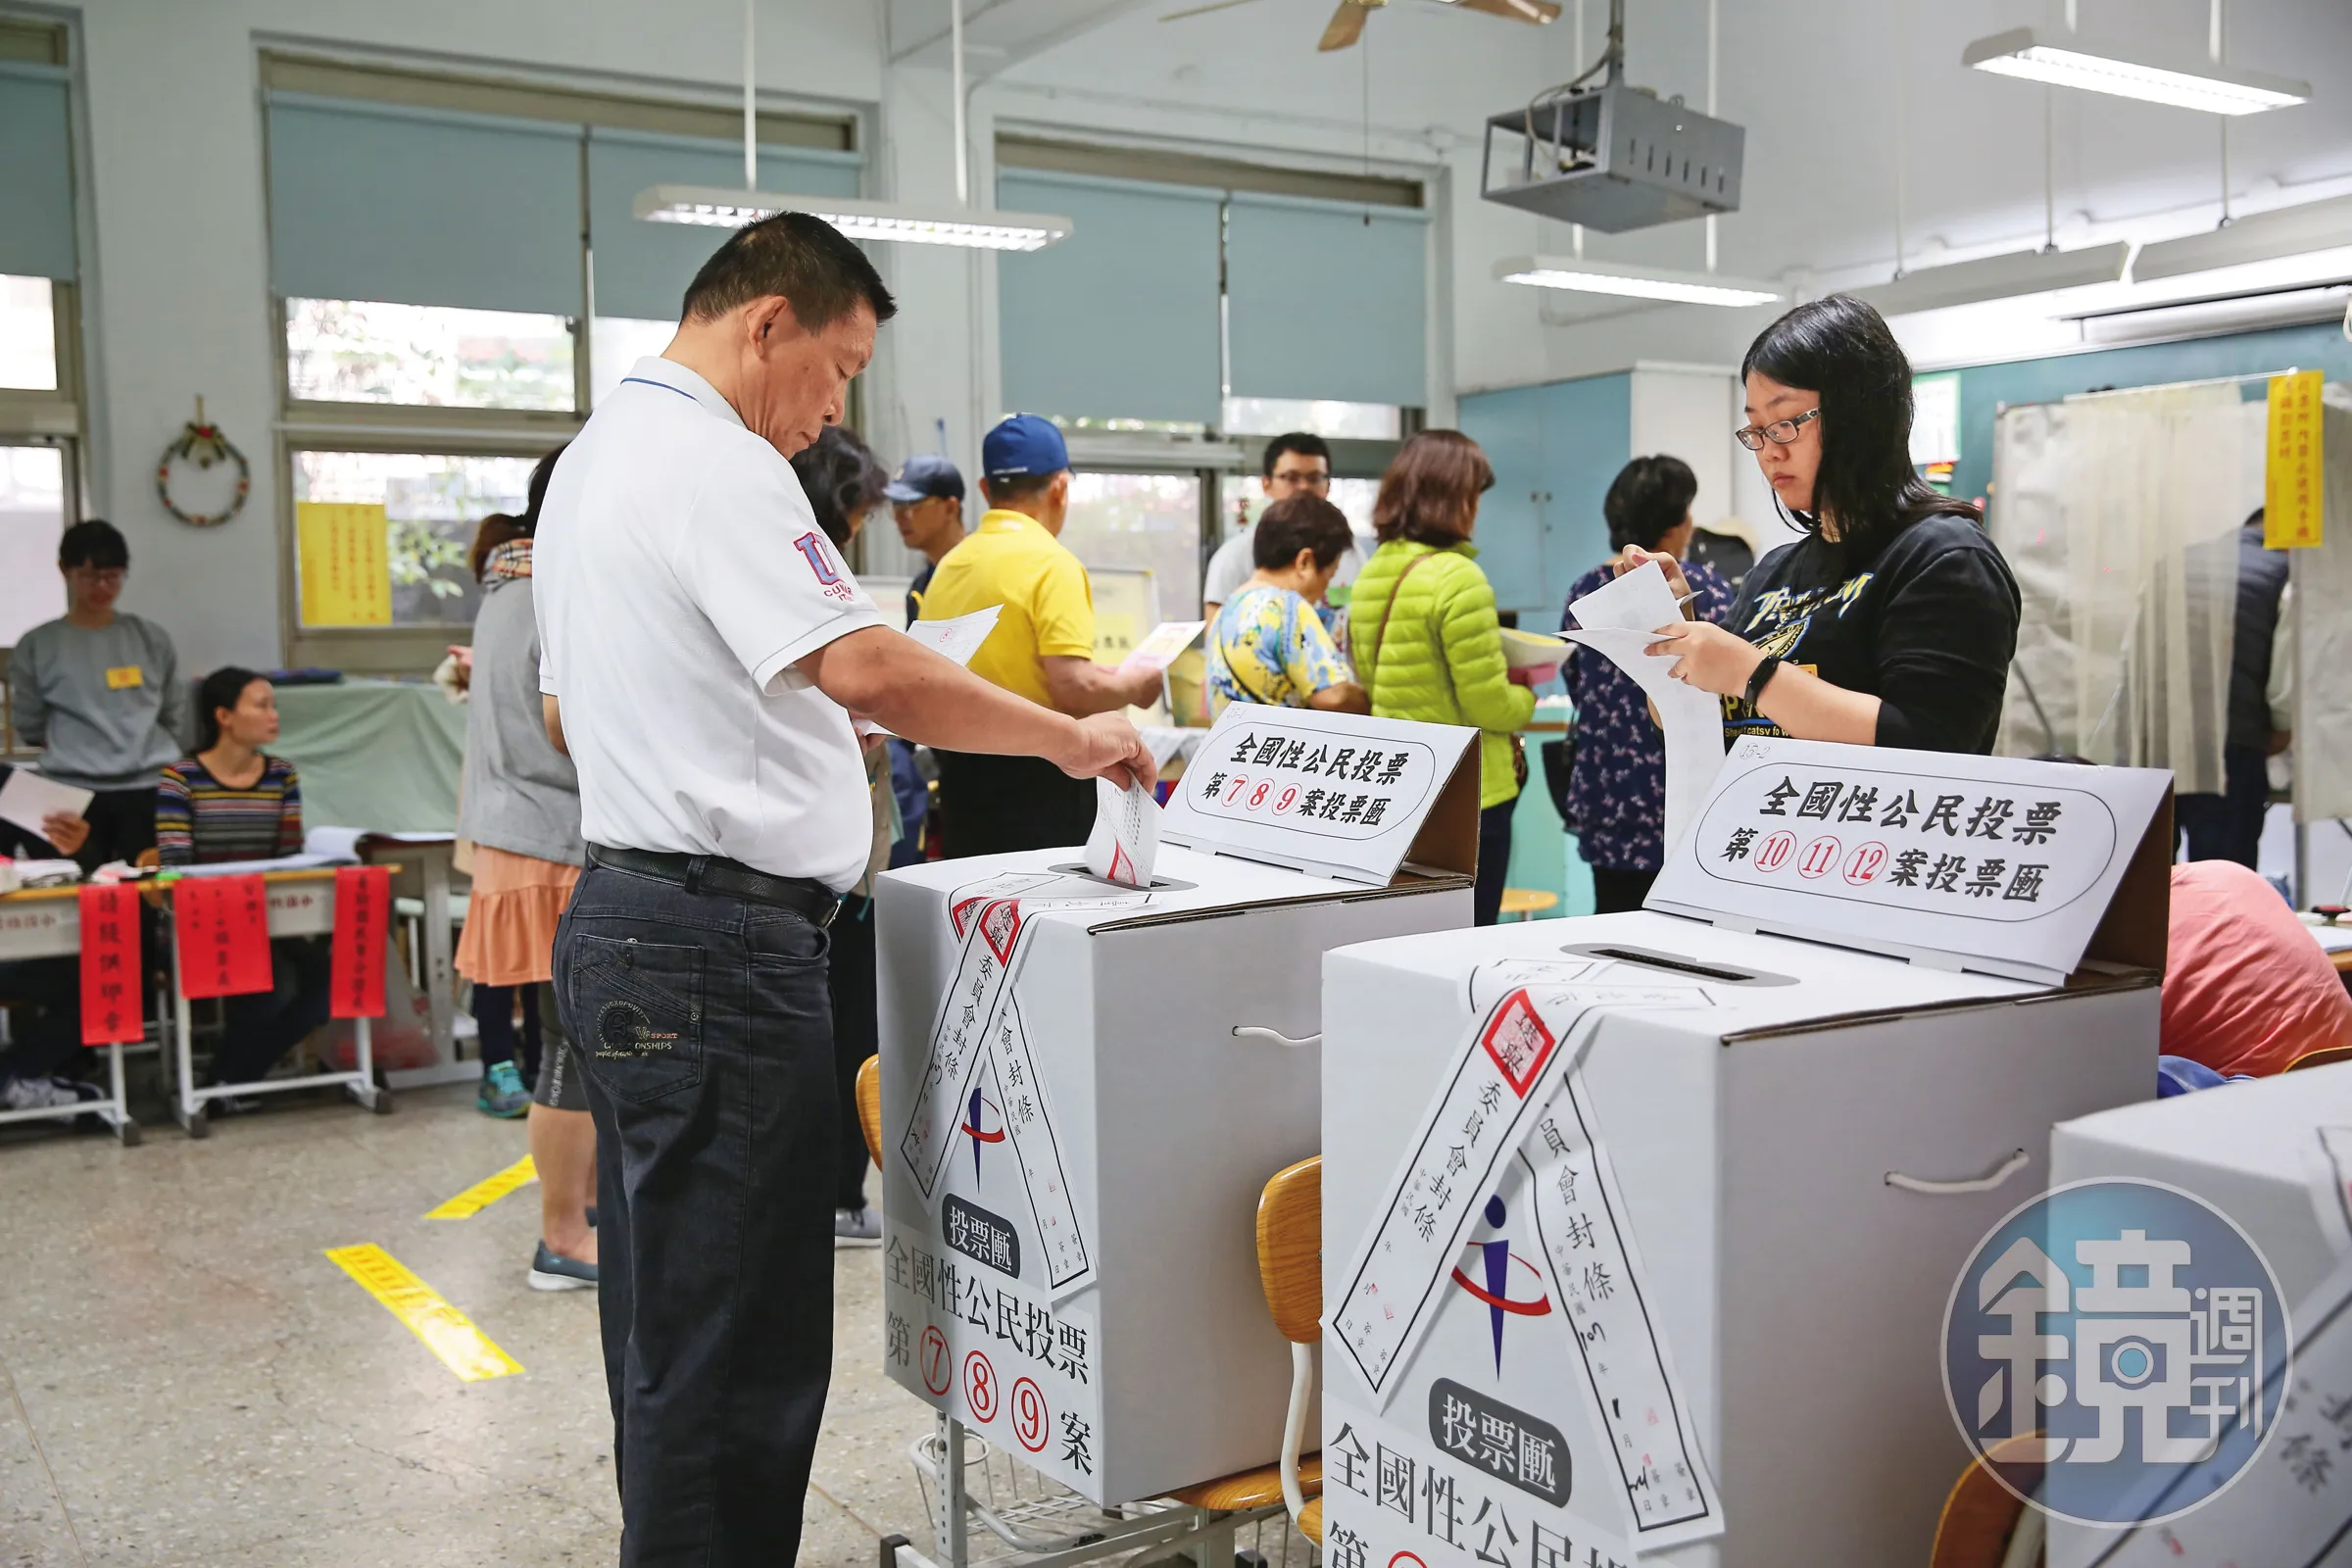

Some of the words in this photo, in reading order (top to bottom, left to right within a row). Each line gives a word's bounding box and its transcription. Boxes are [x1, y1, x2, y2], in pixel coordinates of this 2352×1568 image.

[1230, 732, 1409, 786] 全國性公民投票
[1760, 775, 2063, 846] 全國性公民投票
[950, 1205, 1013, 1272] 投票匭
[886, 1234, 1089, 1385] 全國性公民投票
[1442, 1395, 1557, 1494] 投票匭
[1329, 1422, 1629, 1568] 全國性公民
